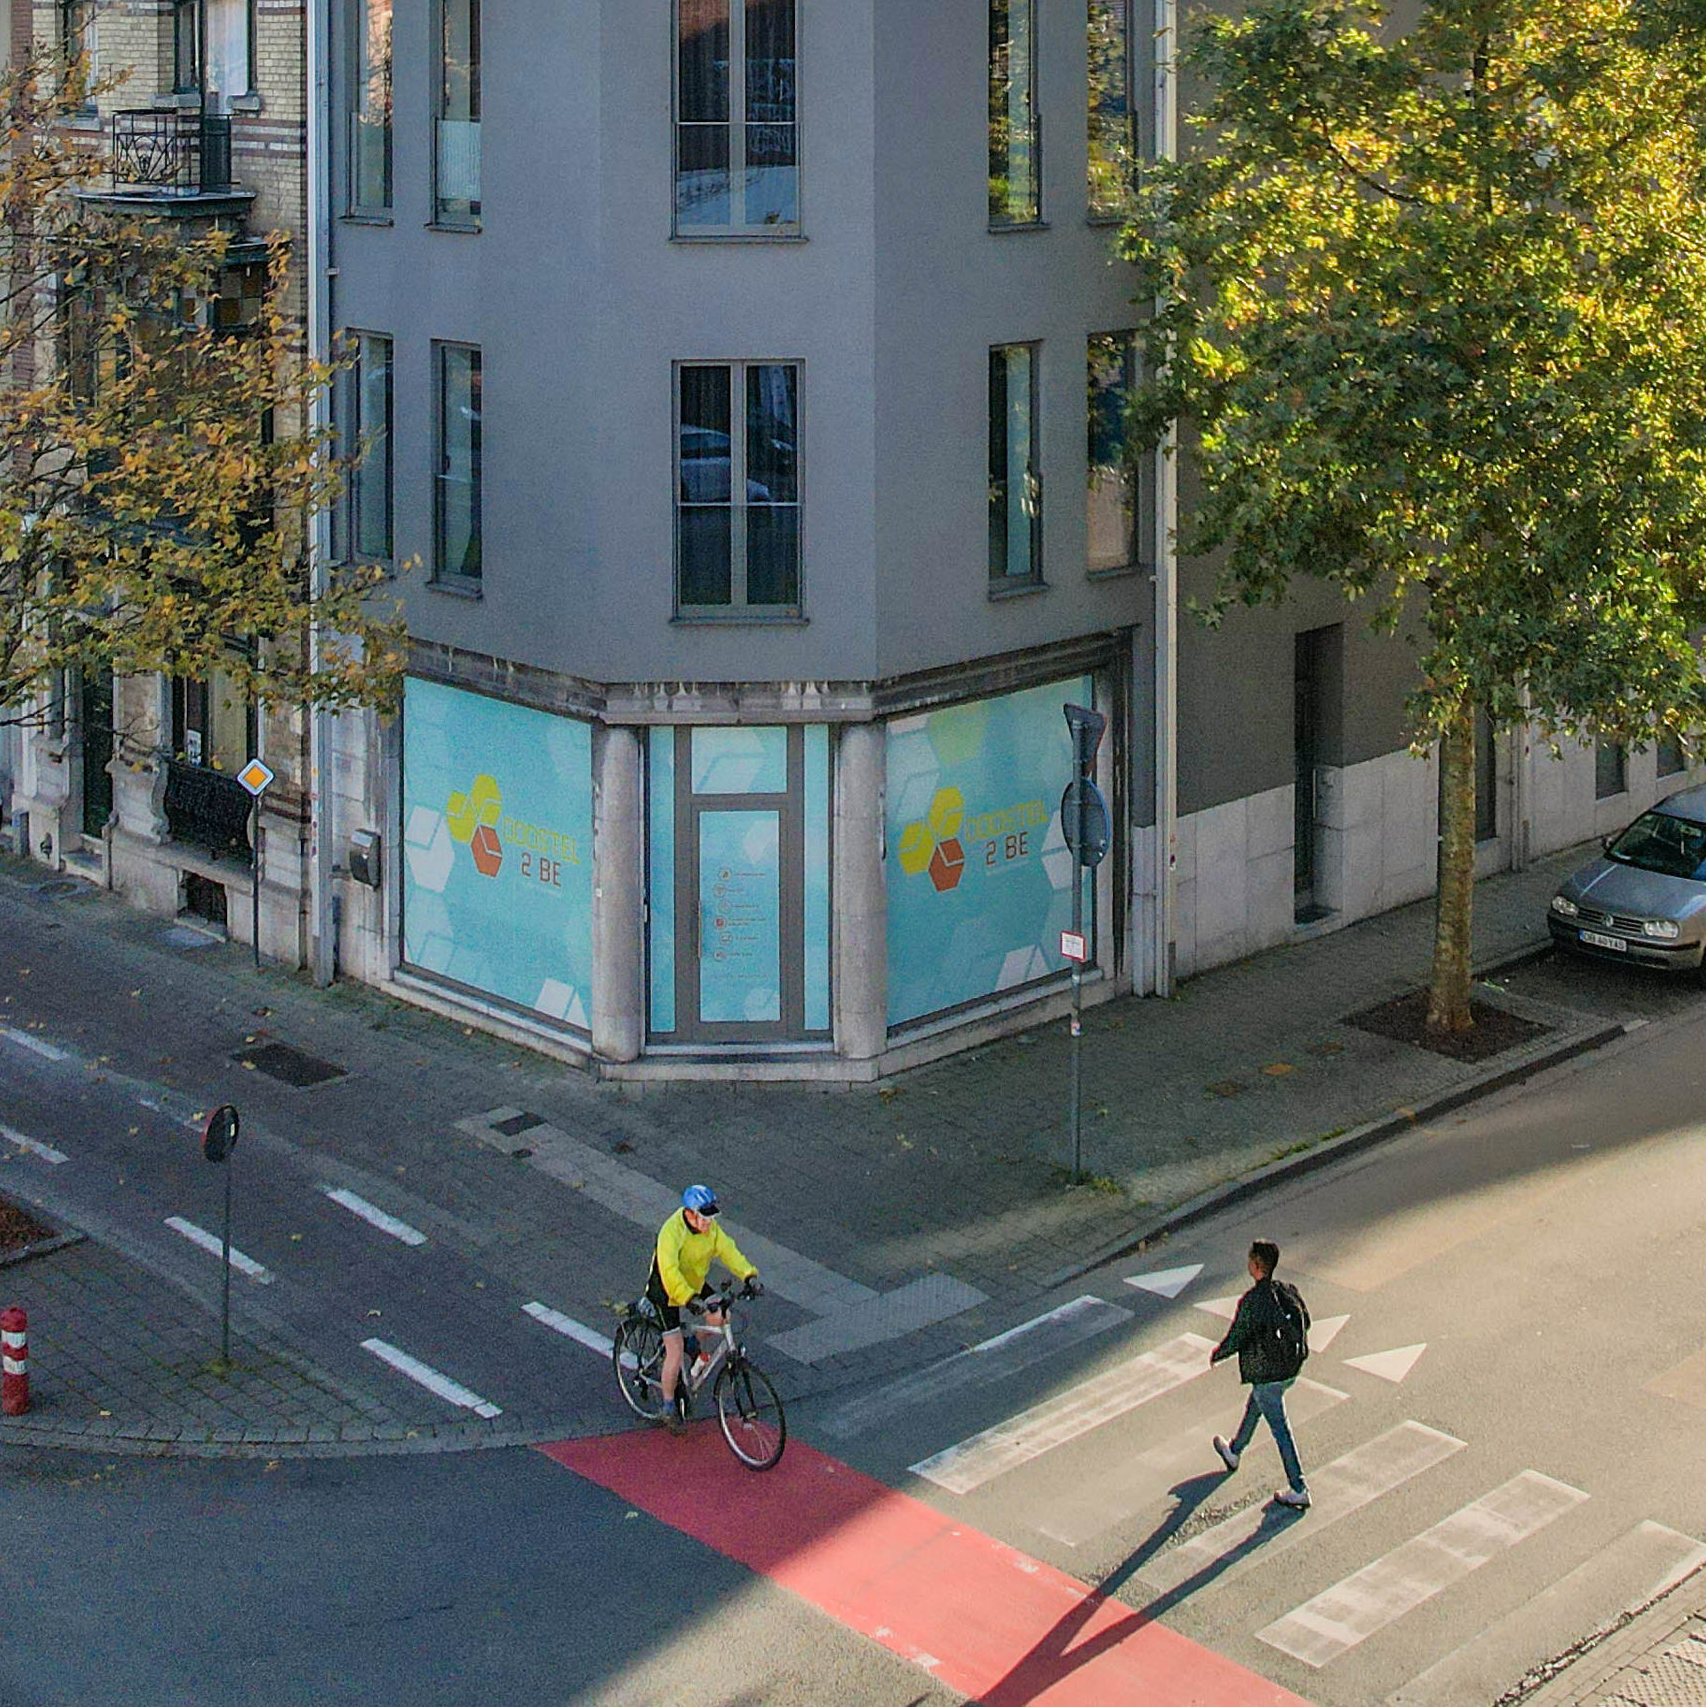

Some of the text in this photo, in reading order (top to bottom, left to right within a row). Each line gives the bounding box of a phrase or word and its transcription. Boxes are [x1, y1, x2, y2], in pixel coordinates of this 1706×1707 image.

[986, 831, 1028, 865] 2 BE
[521, 852, 532, 877] 2
[540, 857, 561, 887] BE
